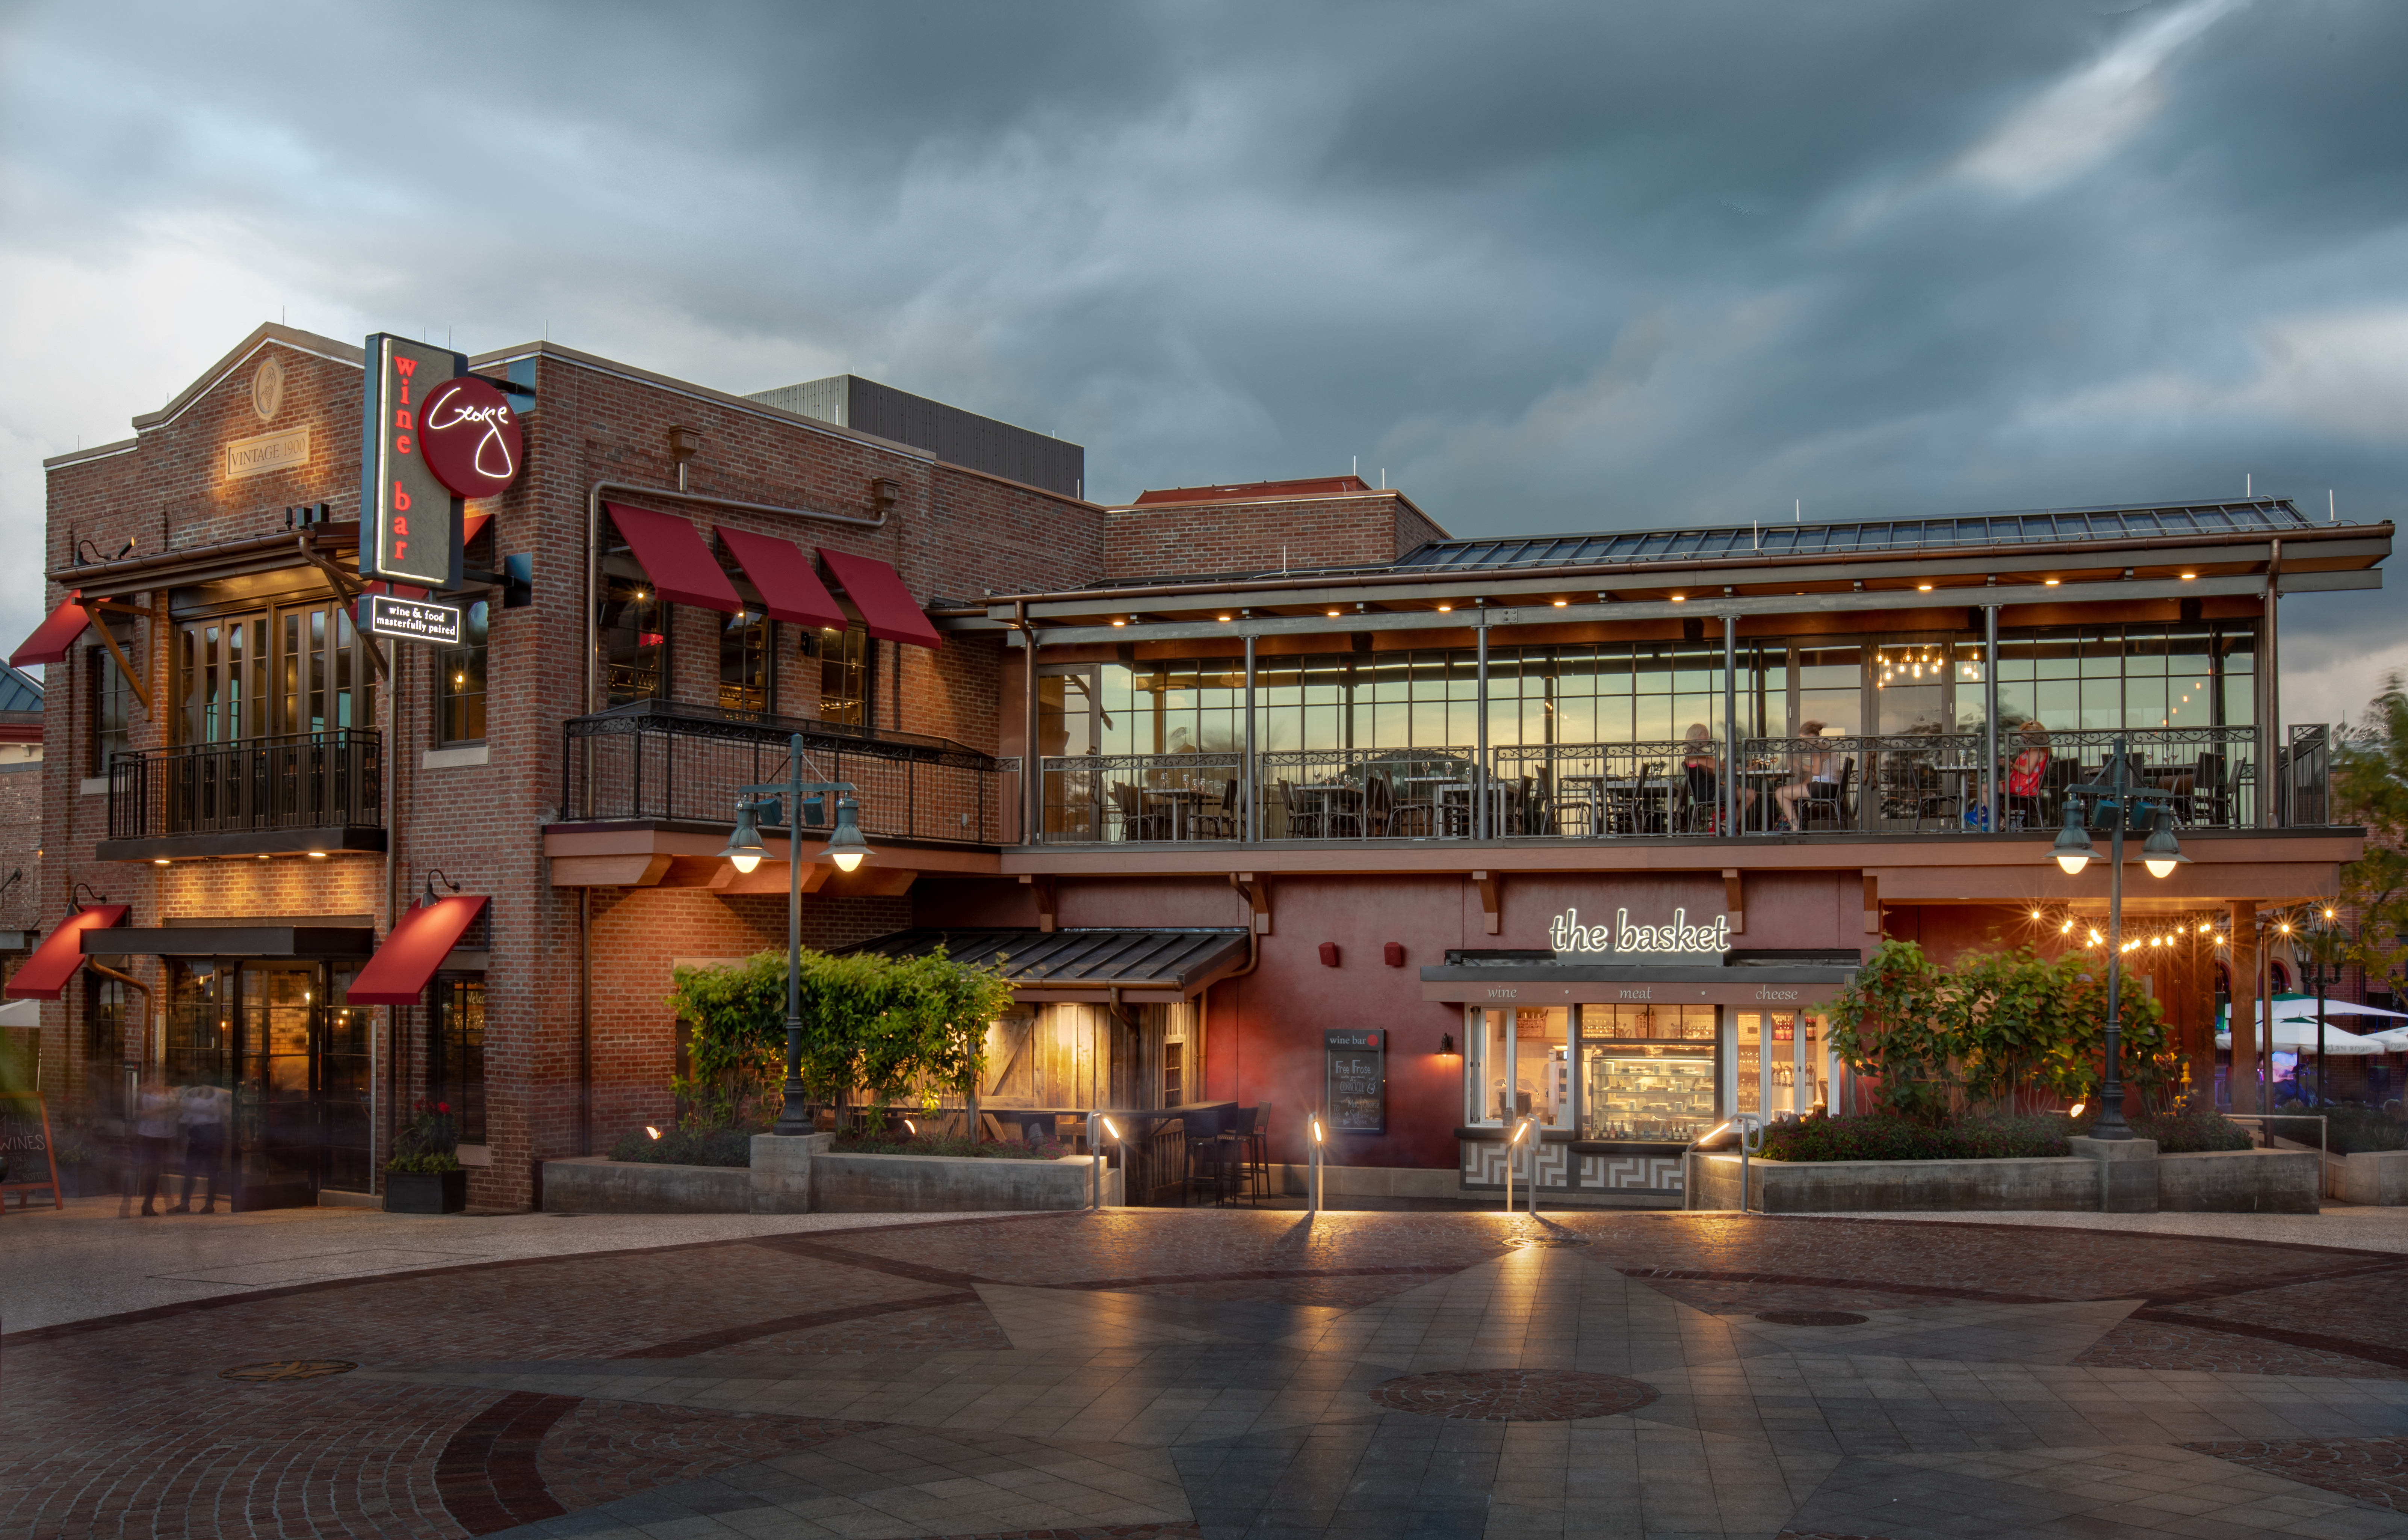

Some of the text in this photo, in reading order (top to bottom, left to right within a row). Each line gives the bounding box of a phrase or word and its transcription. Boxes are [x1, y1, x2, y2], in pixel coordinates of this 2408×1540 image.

[428, 387, 512, 478] George
[231, 438, 305, 466] VINTAGE 1900
[393, 356, 417, 560] wine bar
[389, 606, 444, 622] wine & food
[376, 617, 455, 635] masterfully paired
[1549, 908, 1731, 952] the basket
[1487, 984, 1798, 1000] wine meat cheese
[1329, 1035, 1366, 1044] wine bar
[1335, 1059, 1371, 1074] Free Frose
[1332, 1112, 1340, 1121] GO
[0, 1134, 45, 1151] WINES
